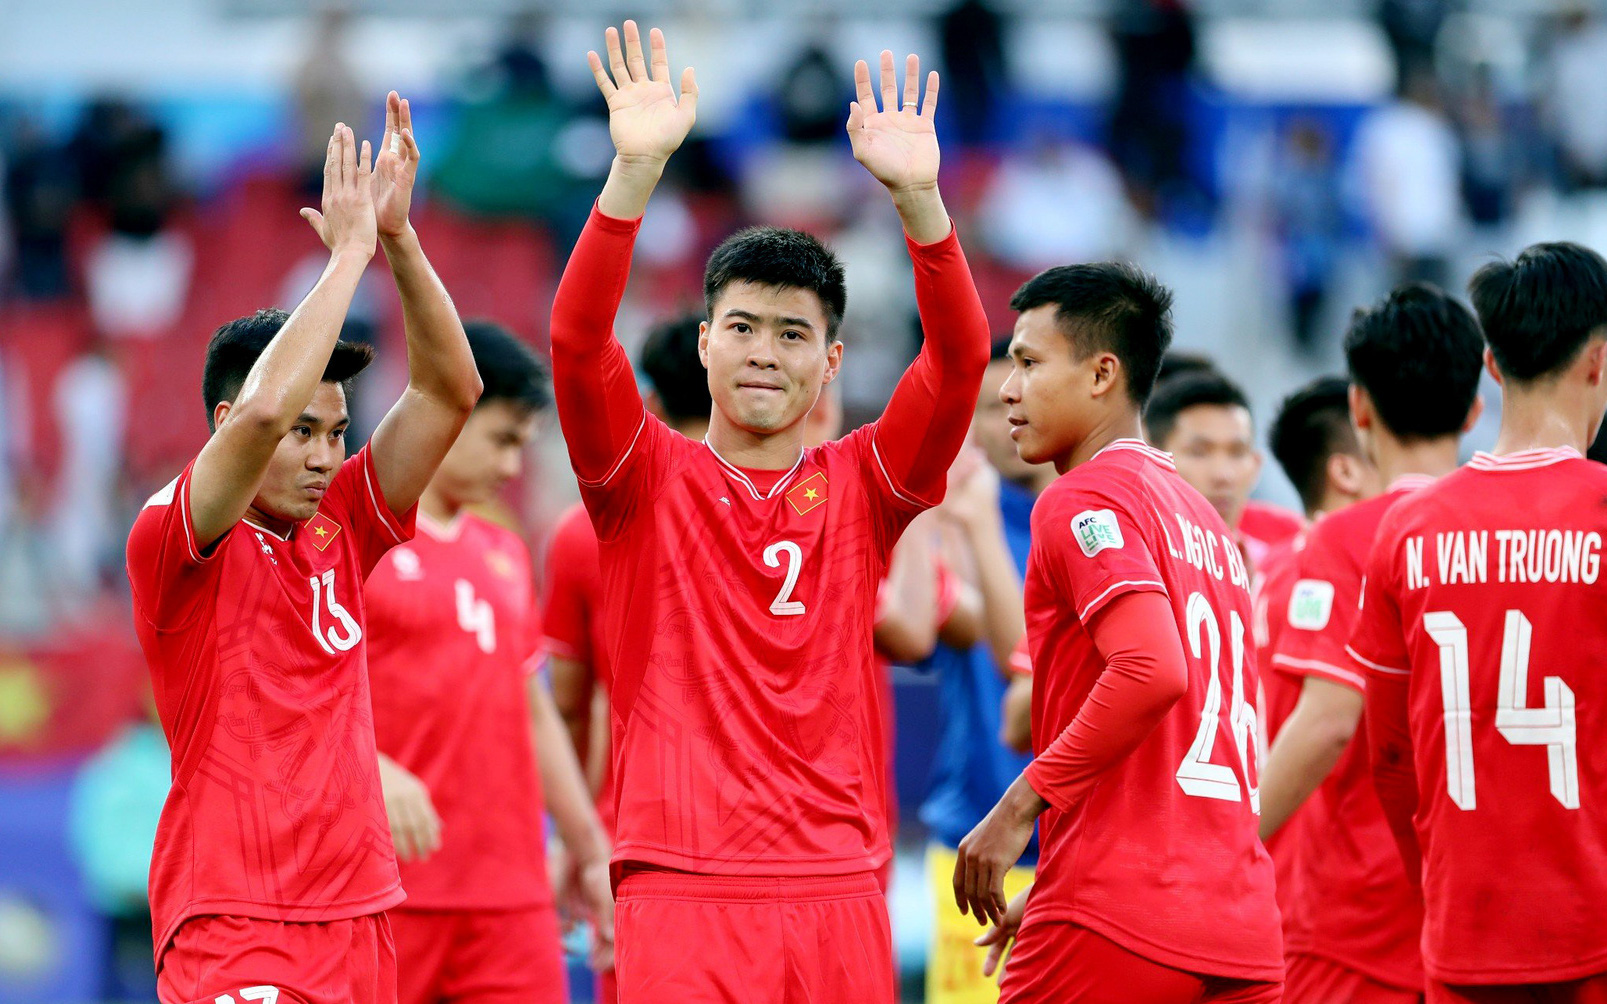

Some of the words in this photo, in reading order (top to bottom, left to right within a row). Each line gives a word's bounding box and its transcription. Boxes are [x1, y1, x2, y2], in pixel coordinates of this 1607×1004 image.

[1079, 517, 1097, 529] AFC
[1081, 524, 1112, 540] LIVE
[1175, 512, 1224, 581] NGOC
[763, 540, 806, 615] 2
[1406, 536, 1430, 590] N.
[1437, 530, 1488, 585] VAN
[1495, 529, 1602, 585] TRUONG
[310, 568, 362, 655] 13
[454, 577, 497, 654] 4
[1423, 609, 1581, 811] 14
